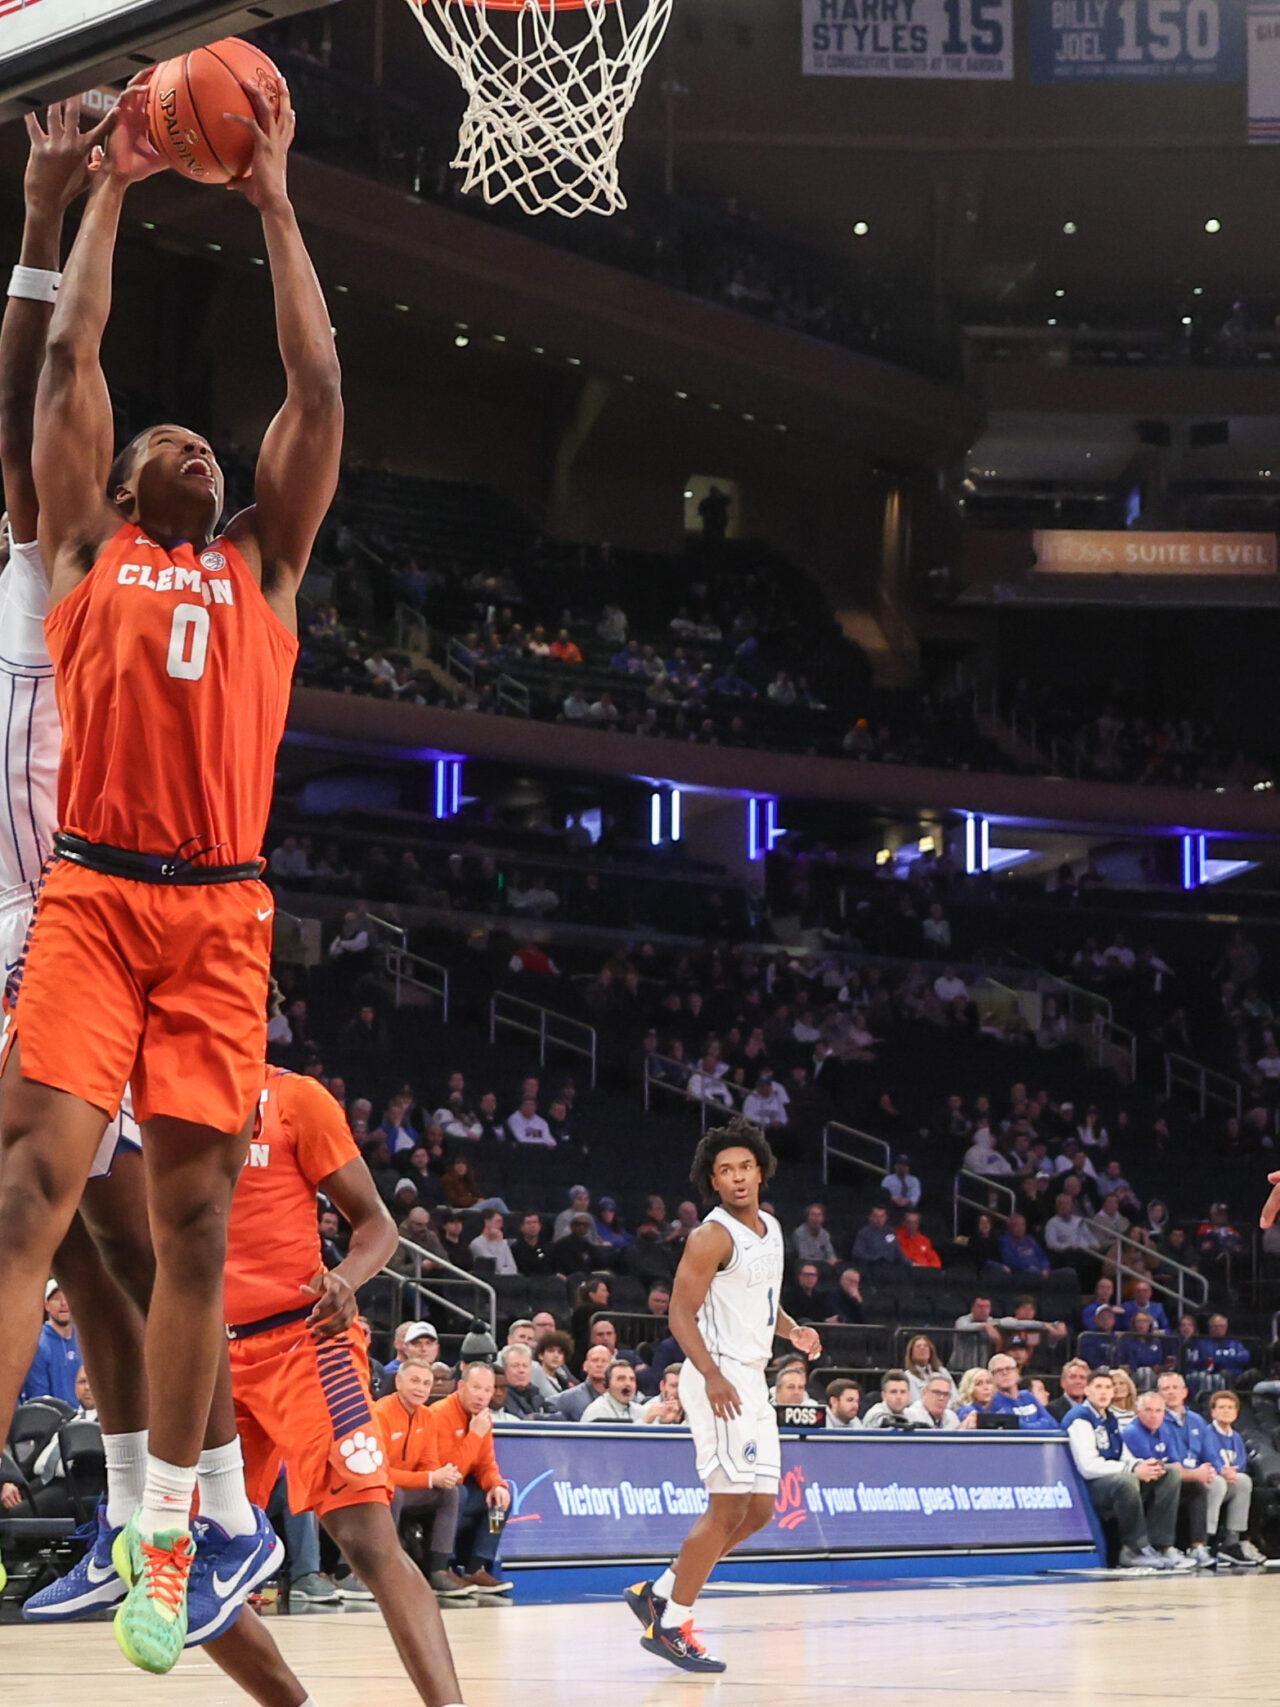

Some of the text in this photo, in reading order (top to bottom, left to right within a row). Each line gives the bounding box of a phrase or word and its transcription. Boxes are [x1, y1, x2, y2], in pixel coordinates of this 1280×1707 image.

[820, 0, 915, 22] HARRY
[942, 0, 1004, 55] 15
[1052, 0, 1107, 29] BILLY
[812, 23, 928, 53] STYLES
[1055, 31, 1106, 61] JOEL
[1117, 0, 1219, 60] 150
[160, 87, 209, 176] SPALDING
[1125, 544, 1191, 563] SUITE
[1198, 545, 1268, 564] LEVEL
[166, 603, 210, 681] 0
[766, 1286, 775, 1327] 1
[785, 1407, 817, 1425] POSS
[553, 1481, 710, 1520] Victory Over Canc
[805, 1482, 823, 1512] of
[822, 1487, 857, 1517] your
[857, 1482, 921, 1512] donation
[919, 1486, 955, 1515] goes
[952, 1484, 970, 1510] to
[969, 1486, 1016, 1510] cancer
[1014, 1481, 1073, 1509] research
